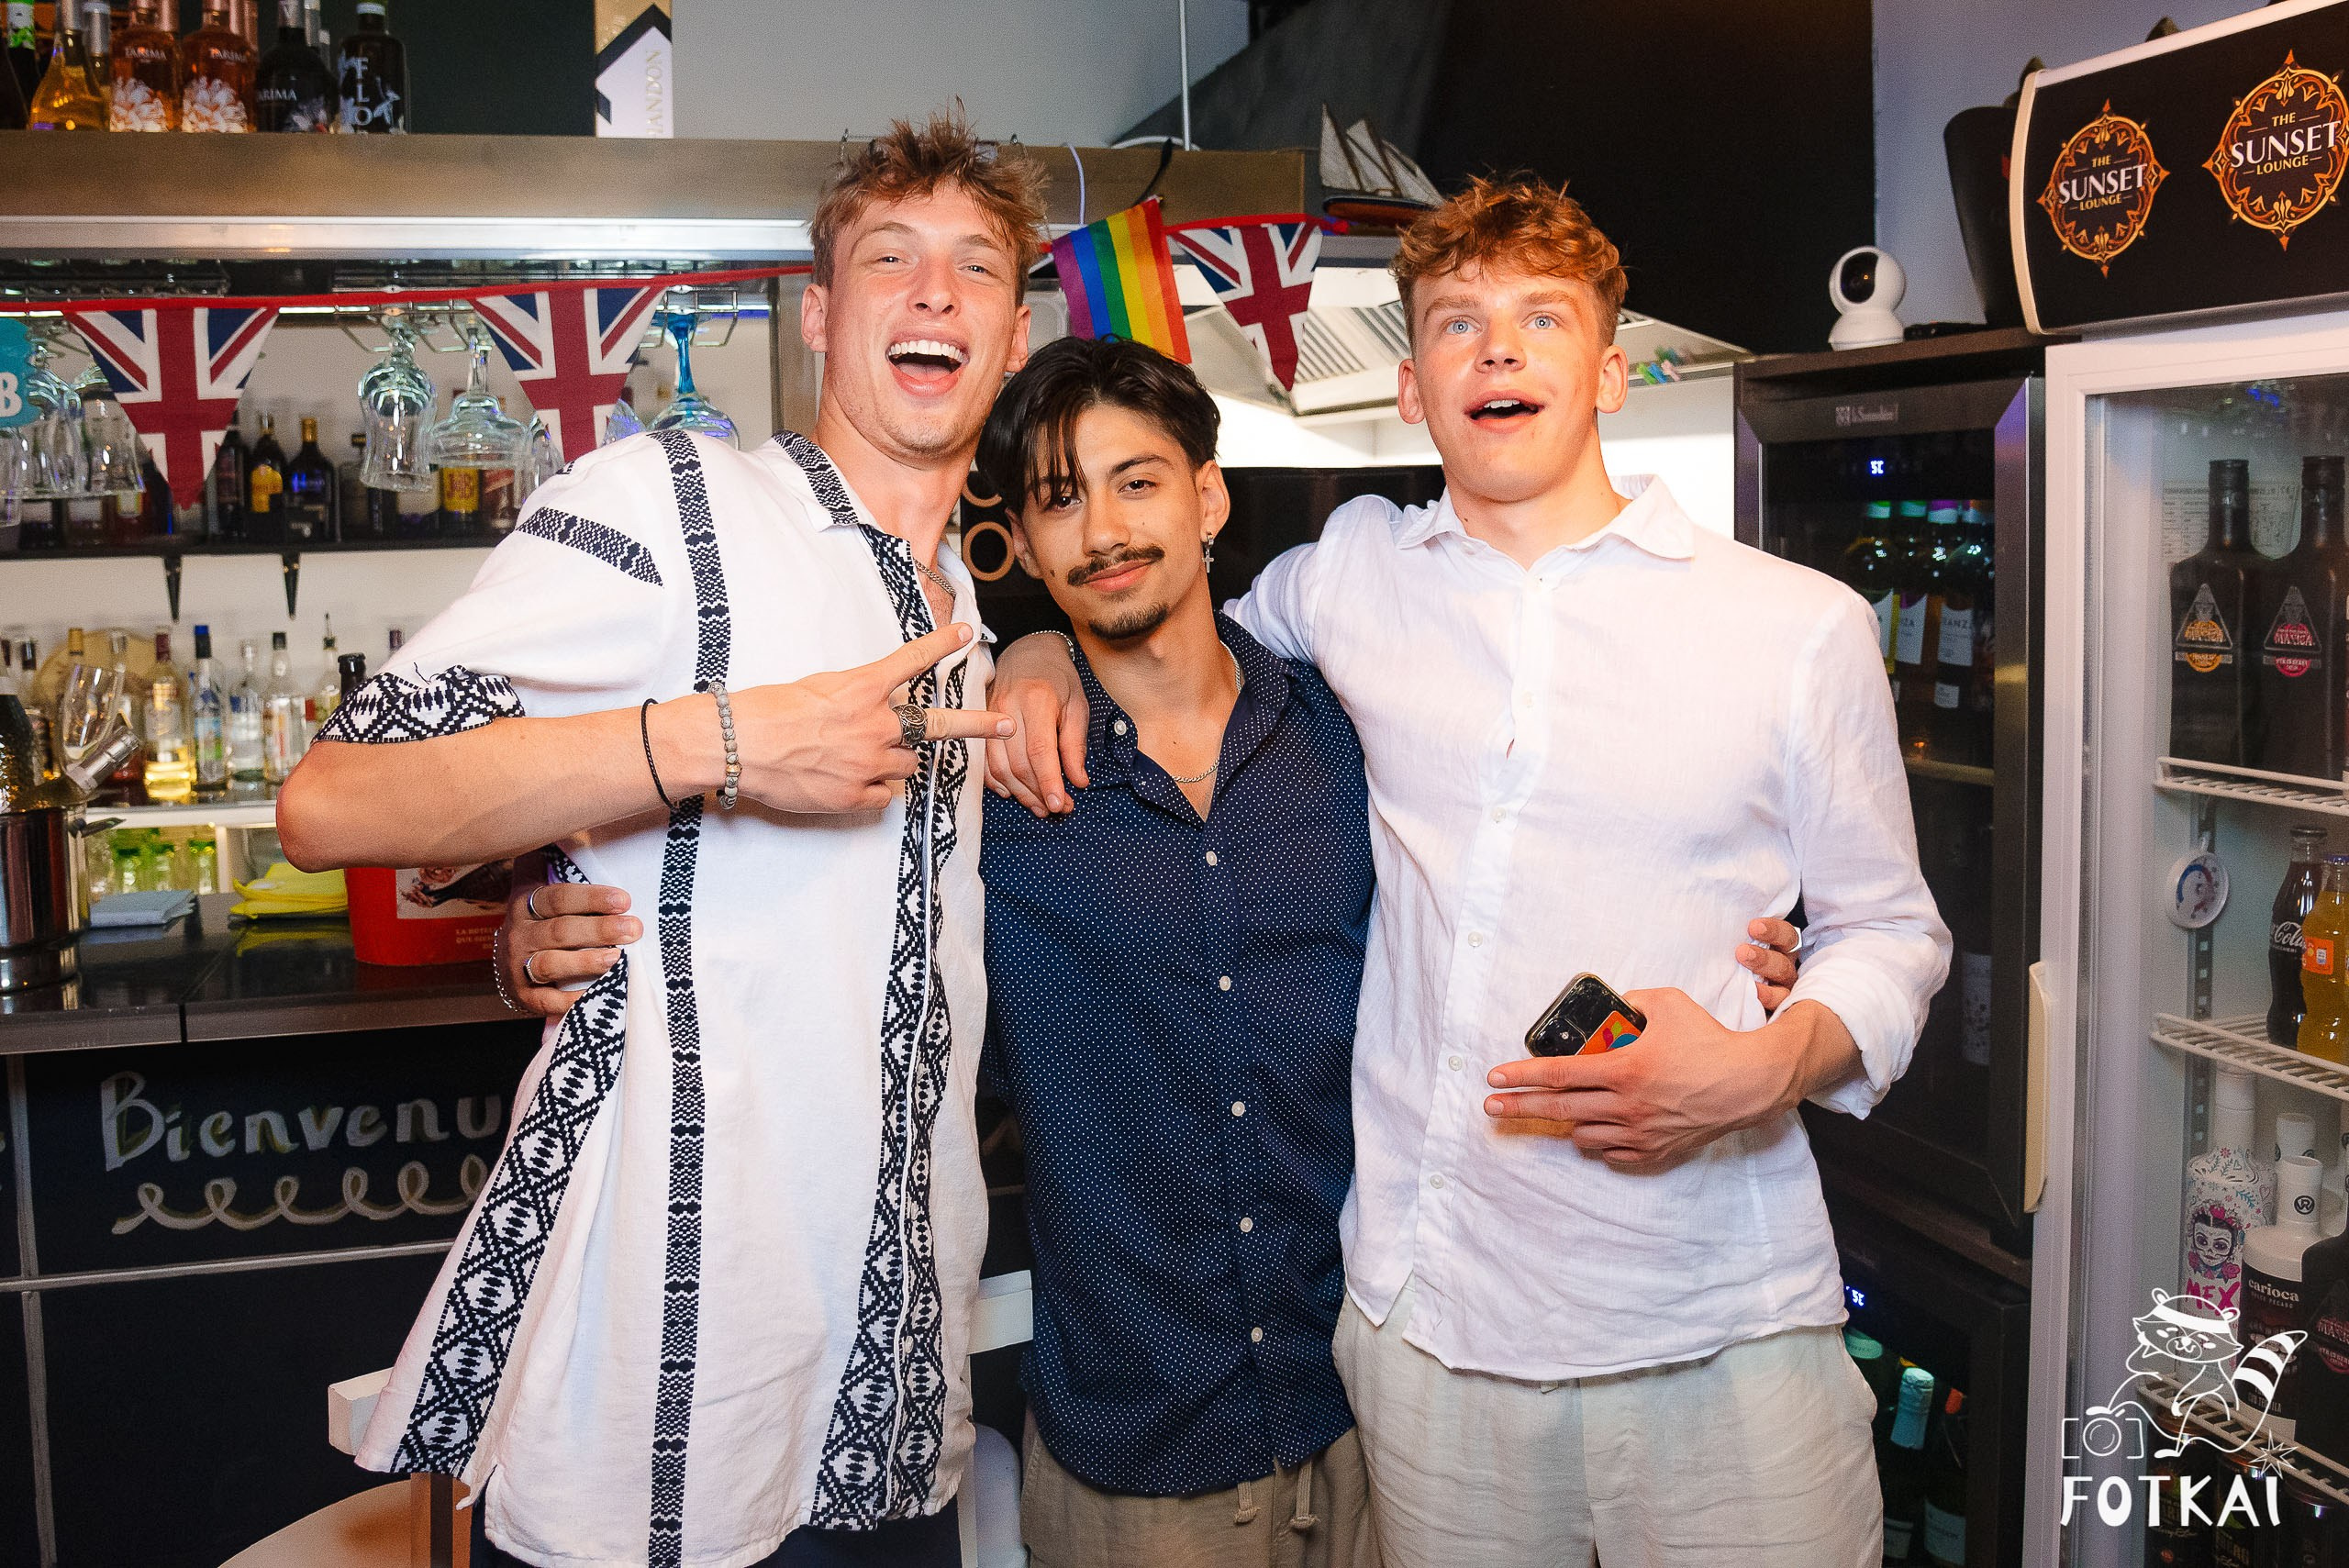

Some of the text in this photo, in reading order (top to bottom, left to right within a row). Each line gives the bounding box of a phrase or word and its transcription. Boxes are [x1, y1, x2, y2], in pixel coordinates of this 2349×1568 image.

[256, 88, 297, 102] ARIMA
[355, 56, 373, 134] FLO
[2272, 112, 2296, 127] THE
[2231, 121, 2342, 168] SUNSET
[2091, 155, 2111, 168] THE
[2256, 154, 2309, 175] LOUNGE
[2058, 163, 2148, 205] SUNSET
[2079, 194, 2122, 211] LOUNGE
[2274, 920, 2306, 949] Cola
[101, 1070, 502, 1172] Bienvenu
[2248, 1278, 2299, 1302] carioca
